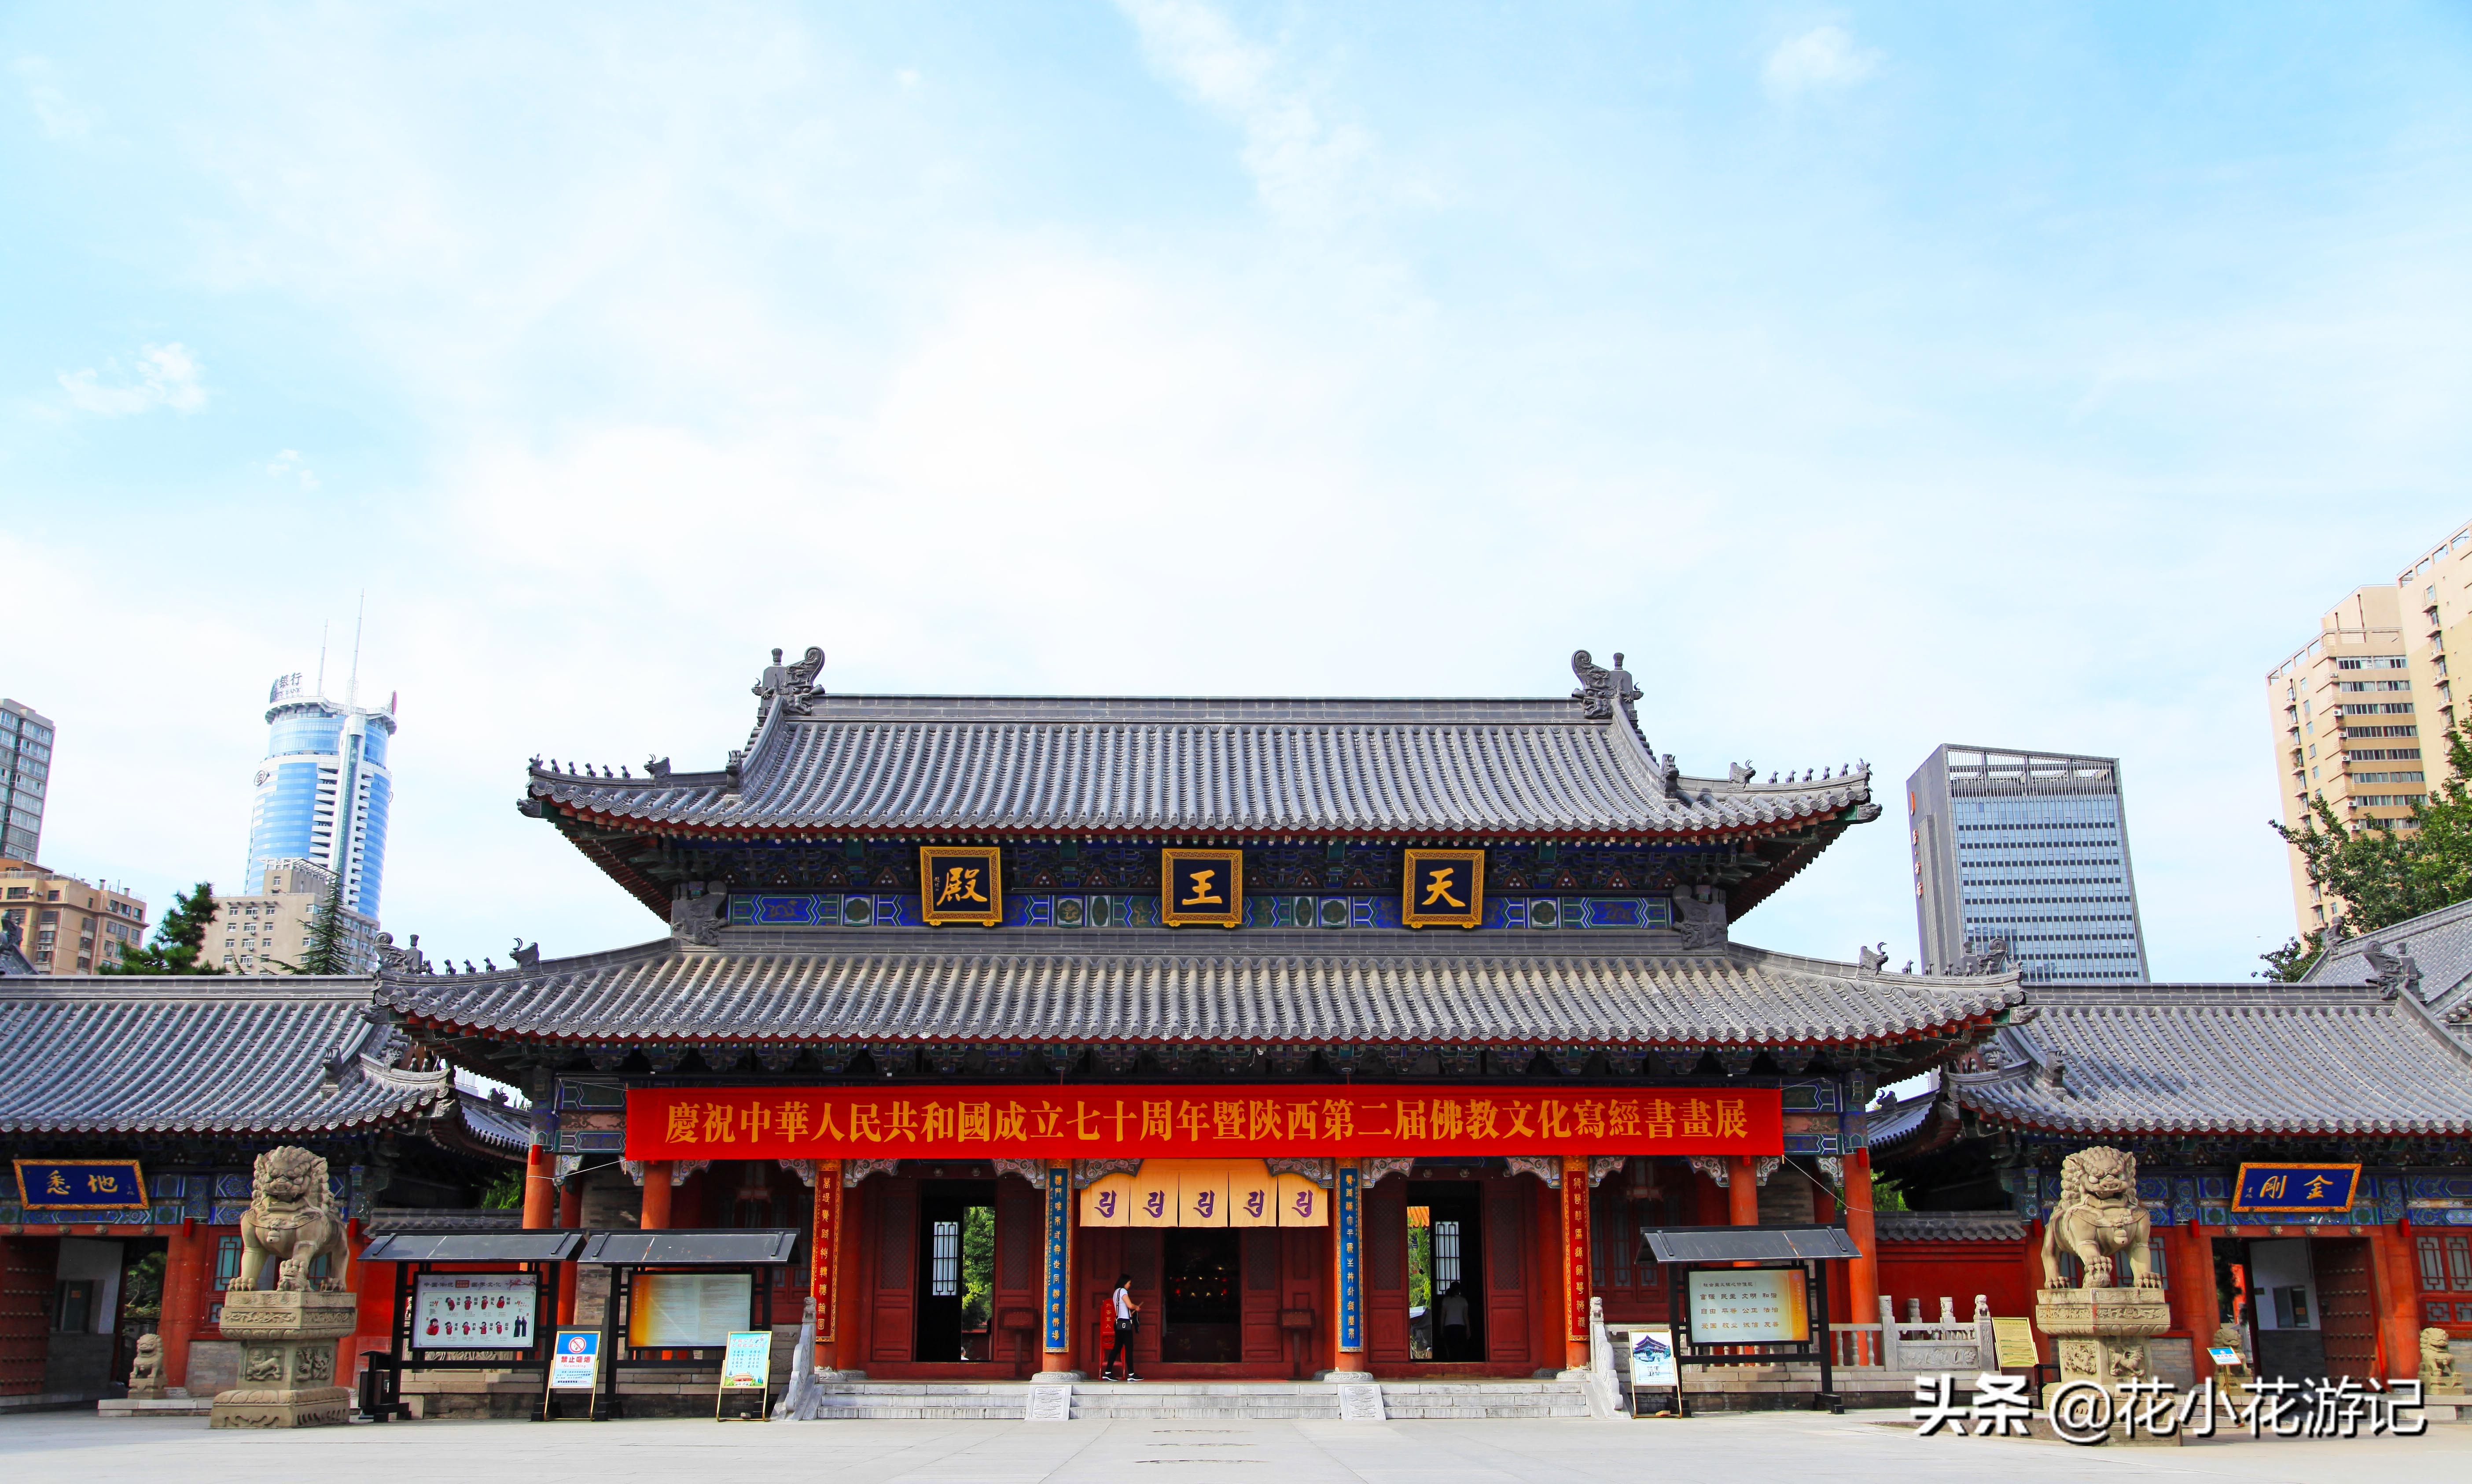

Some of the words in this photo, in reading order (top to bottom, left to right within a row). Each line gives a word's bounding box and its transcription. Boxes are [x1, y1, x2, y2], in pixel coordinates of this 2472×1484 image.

[937, 867, 987, 906] 殿
[1182, 870, 1222, 905] 王
[1422, 867, 1466, 907] 天
